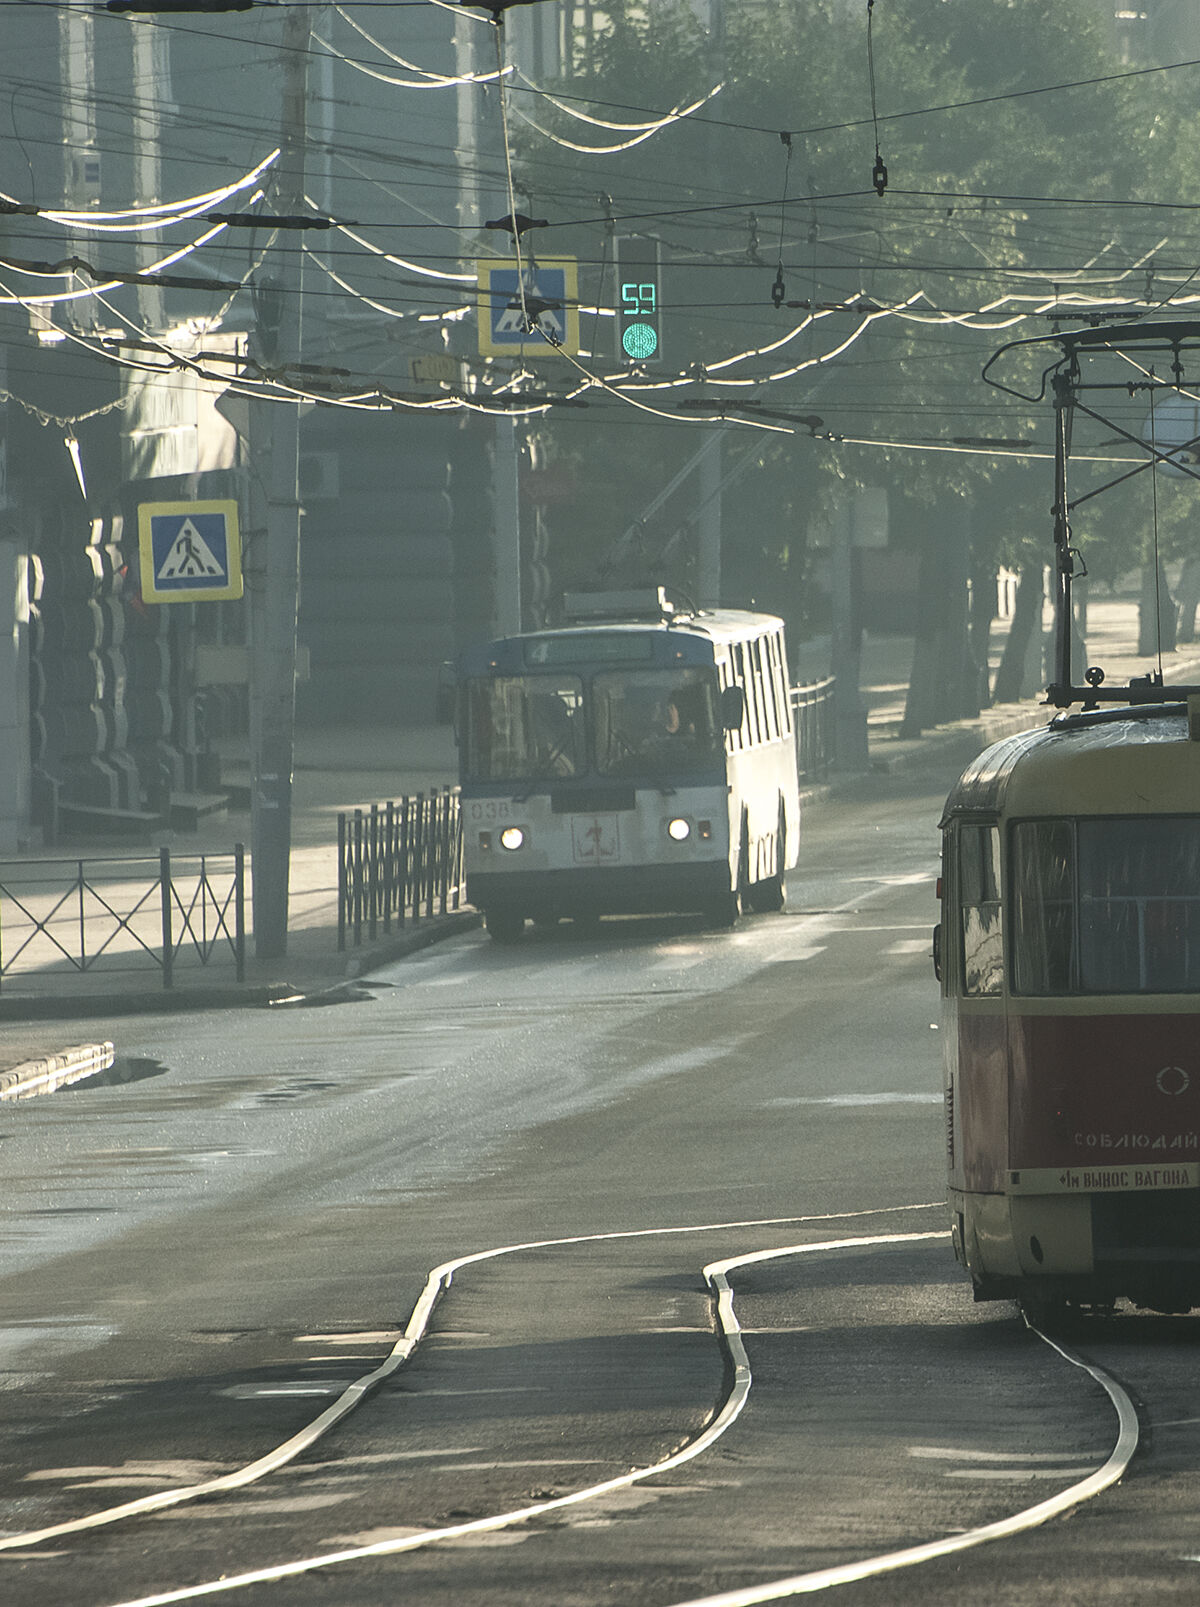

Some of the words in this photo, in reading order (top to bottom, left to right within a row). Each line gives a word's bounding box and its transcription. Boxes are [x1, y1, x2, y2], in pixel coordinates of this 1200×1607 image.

[622, 284, 655, 315] 59
[1075, 1132, 1198, 1149] СОБЛЮДАЙ
[1083, 1171, 1129, 1188] ВЫНОС
[1135, 1169, 1189, 1187] ВАГОНА
